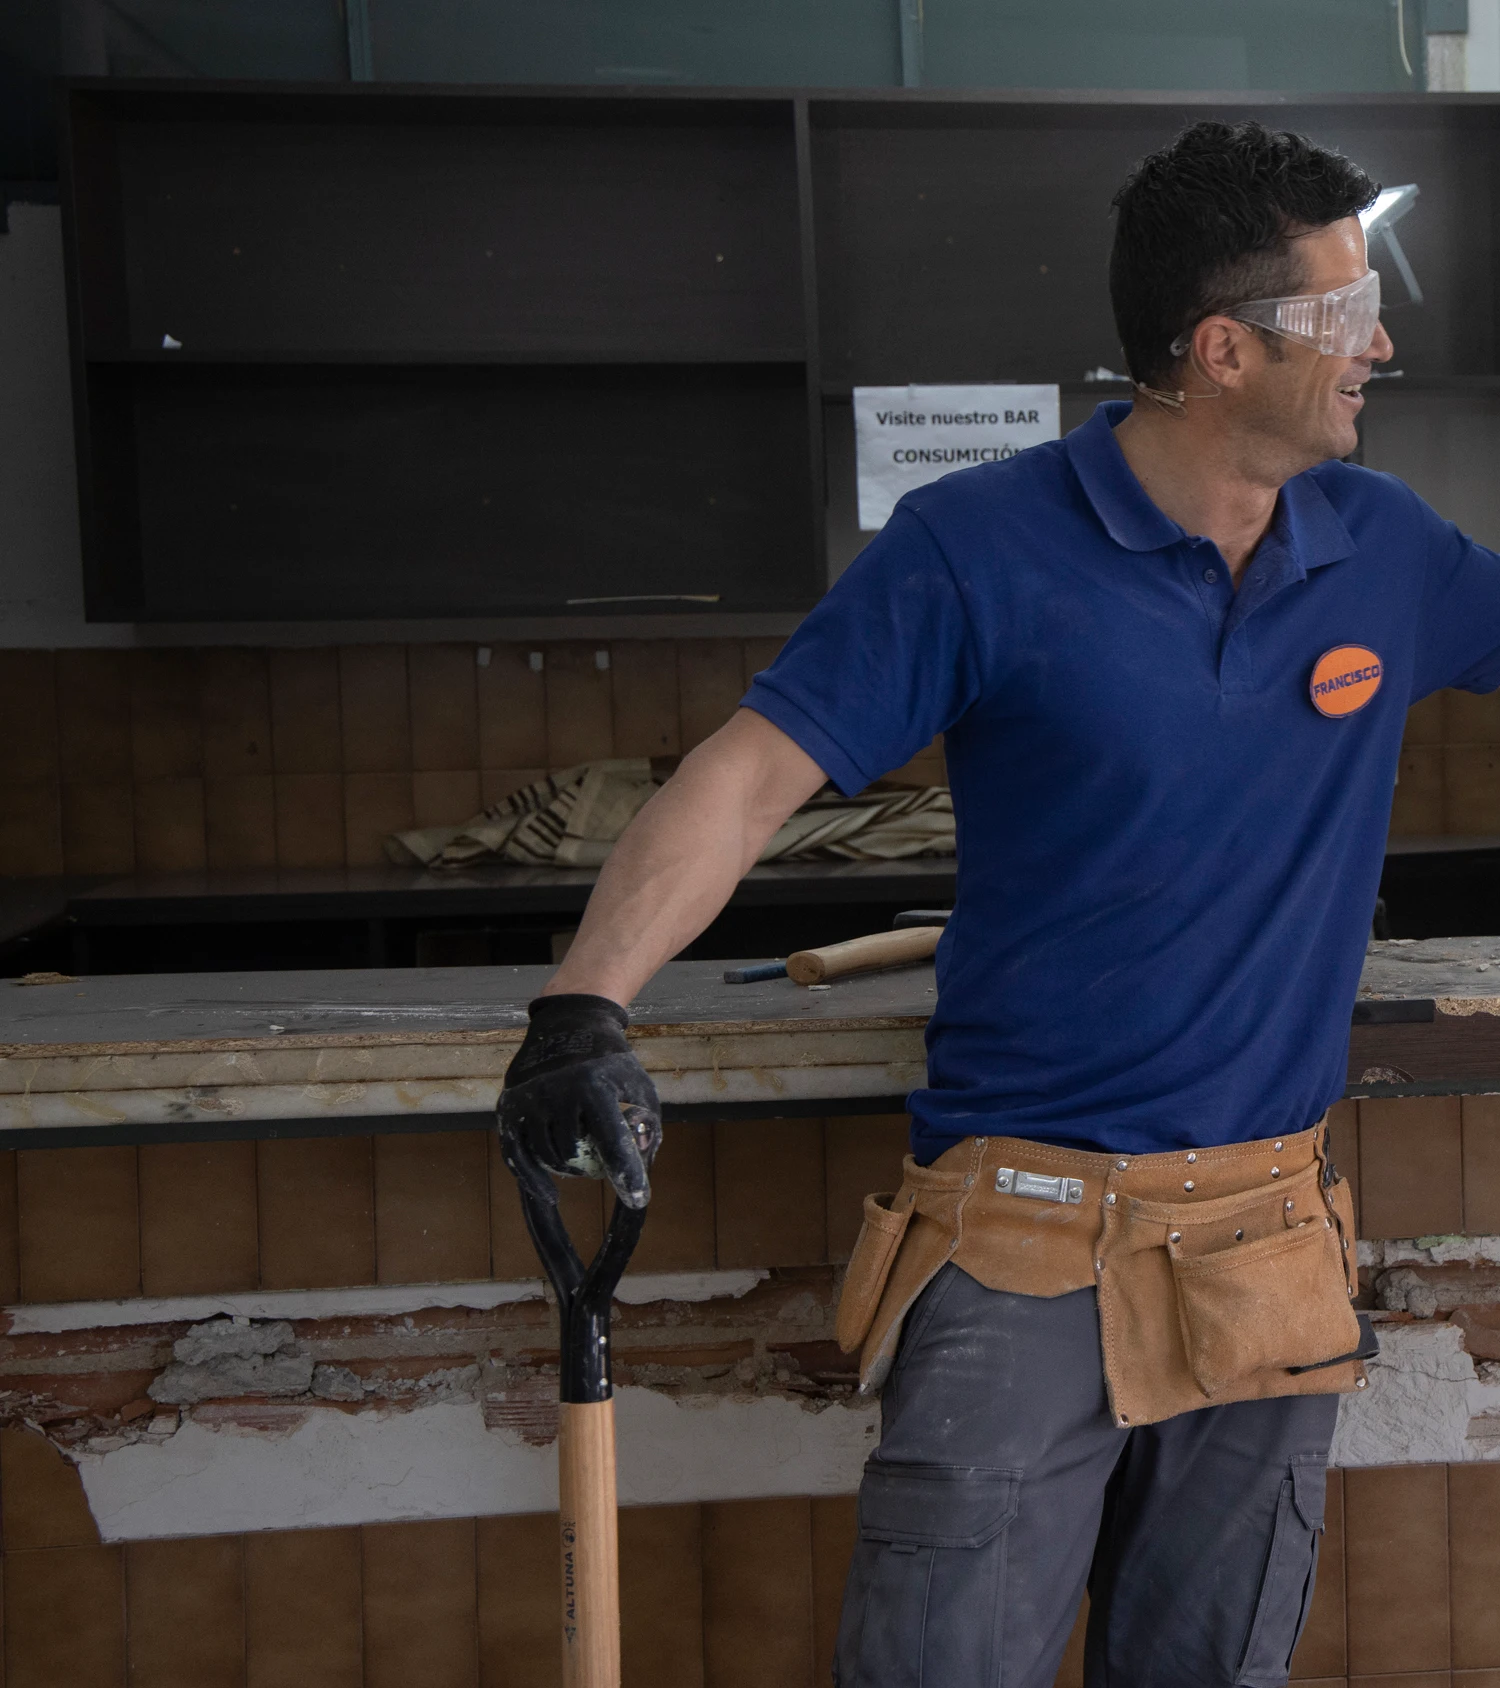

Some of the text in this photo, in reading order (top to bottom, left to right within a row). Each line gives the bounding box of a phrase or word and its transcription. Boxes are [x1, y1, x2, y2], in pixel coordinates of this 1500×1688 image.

[876, 409, 1040, 426] Visite nuestro BAR
[893, 443, 1022, 463] CONSUMICIÓ
[1313, 664, 1380, 698] FRANCISCO
[565, 1551, 575, 1620] ALTUNA
